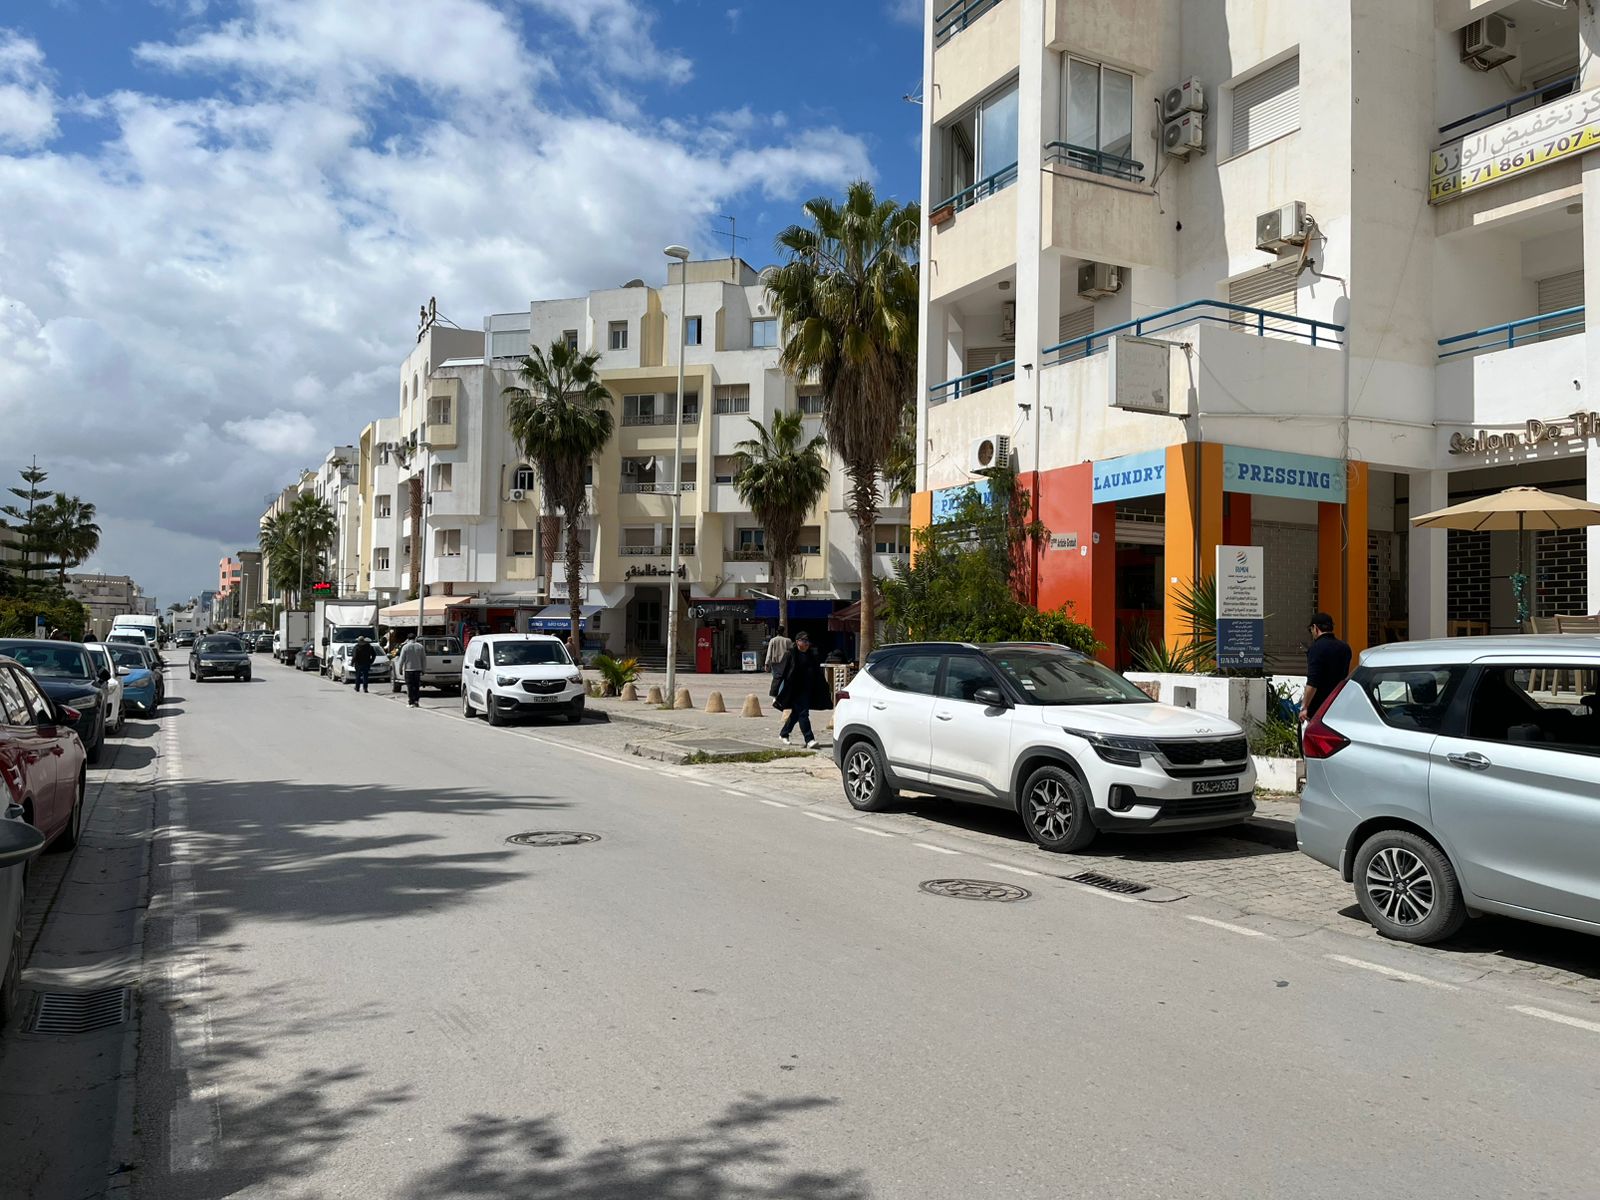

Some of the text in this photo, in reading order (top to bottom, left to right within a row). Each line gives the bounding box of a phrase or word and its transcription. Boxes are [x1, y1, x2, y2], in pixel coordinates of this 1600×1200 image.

[1491, 103, 1573, 154] تخفيض
[1435, 134, 1487, 174] الوزن
[1470, 165, 1491, 182] 71
[1500, 149, 1535, 172] 861
[1543, 131, 1584, 157] 707
[1448, 429, 1517, 455] Salon
[1093, 465, 1164, 491] LAUNDRY
[1237, 463, 1330, 489] PRESSING
[1195, 782, 1209, 793] 234
